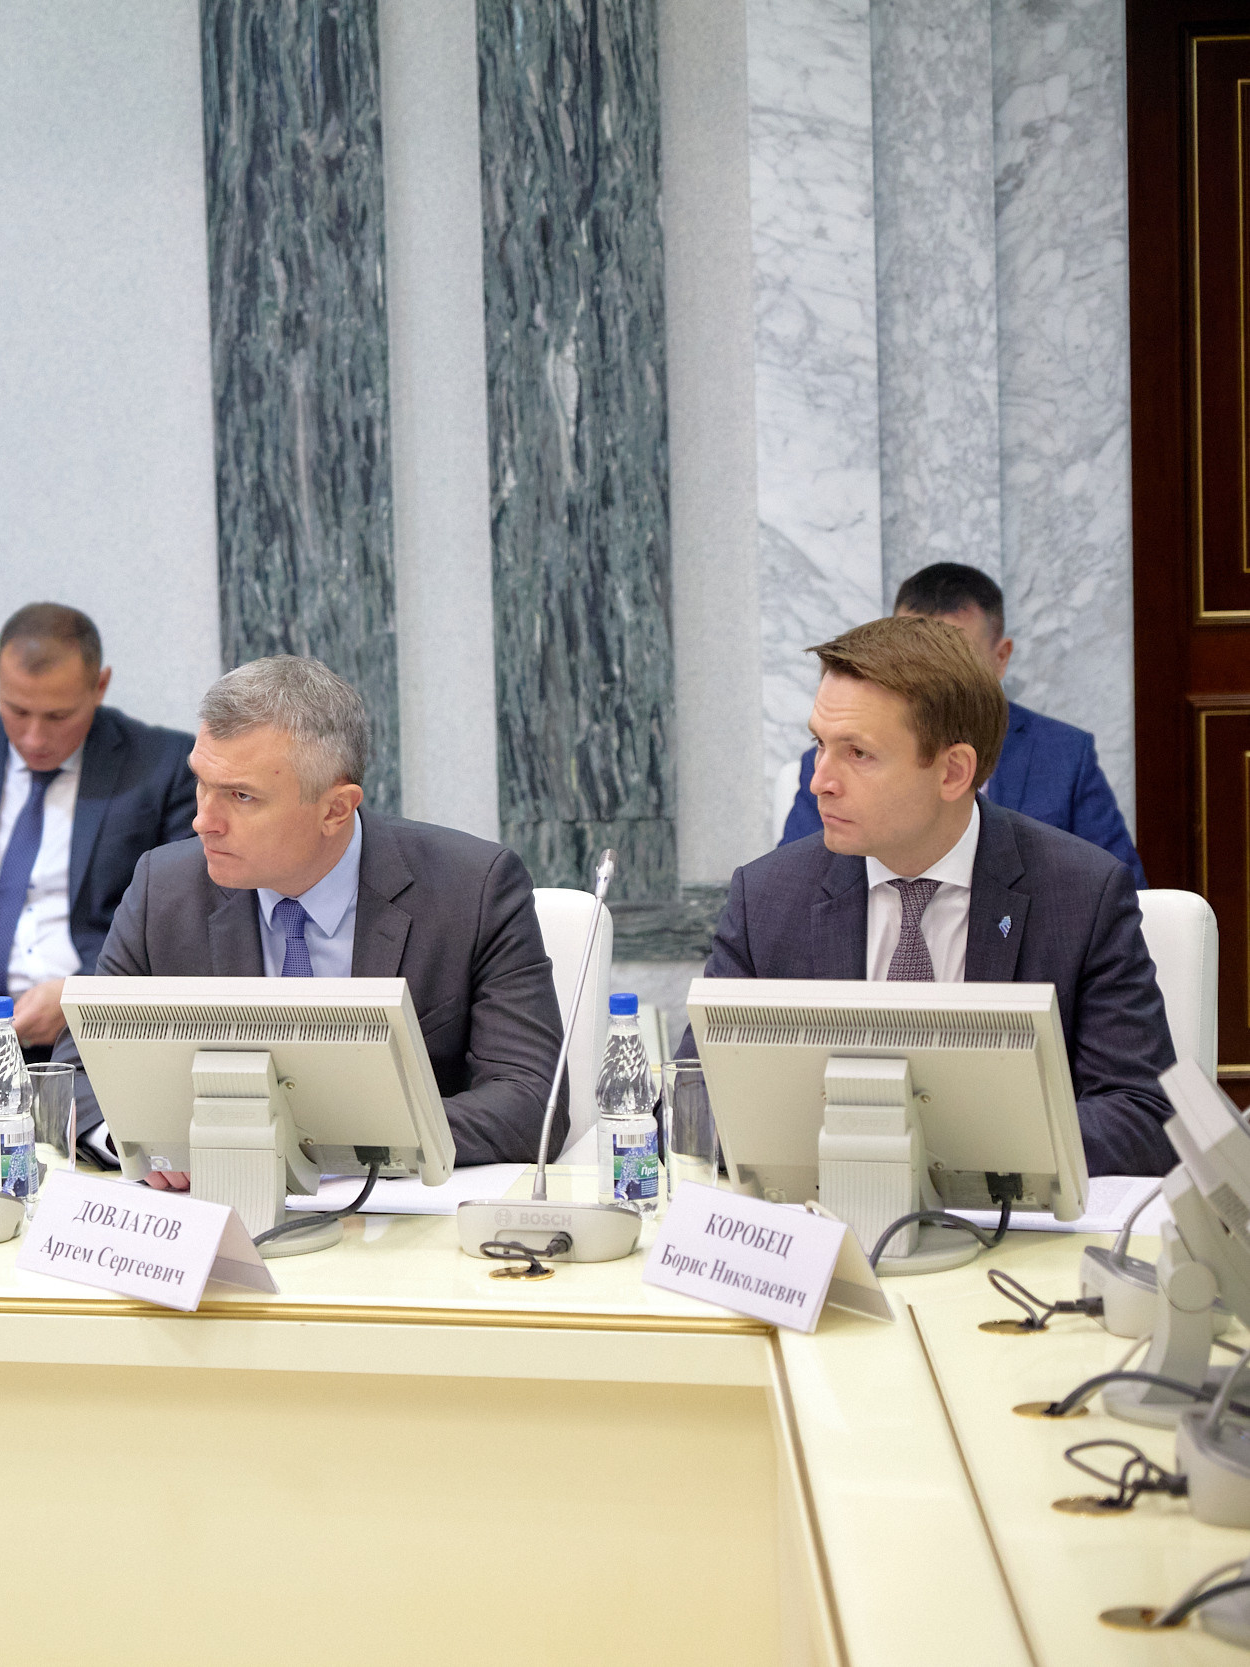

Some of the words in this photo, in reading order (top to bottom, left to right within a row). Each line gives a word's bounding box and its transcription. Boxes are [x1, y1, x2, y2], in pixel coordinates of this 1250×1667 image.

[72, 1200, 182, 1241] ДОВЛАТОВ
[520, 1213, 572, 1227] BOSCH
[704, 1213, 794, 1260] КОРОБЕЦ
[39, 1234, 94, 1263] Артем
[97, 1246, 185, 1286] Сергеевич
[660, 1244, 707, 1277] Борис
[710, 1259, 807, 1308] Николаевич
